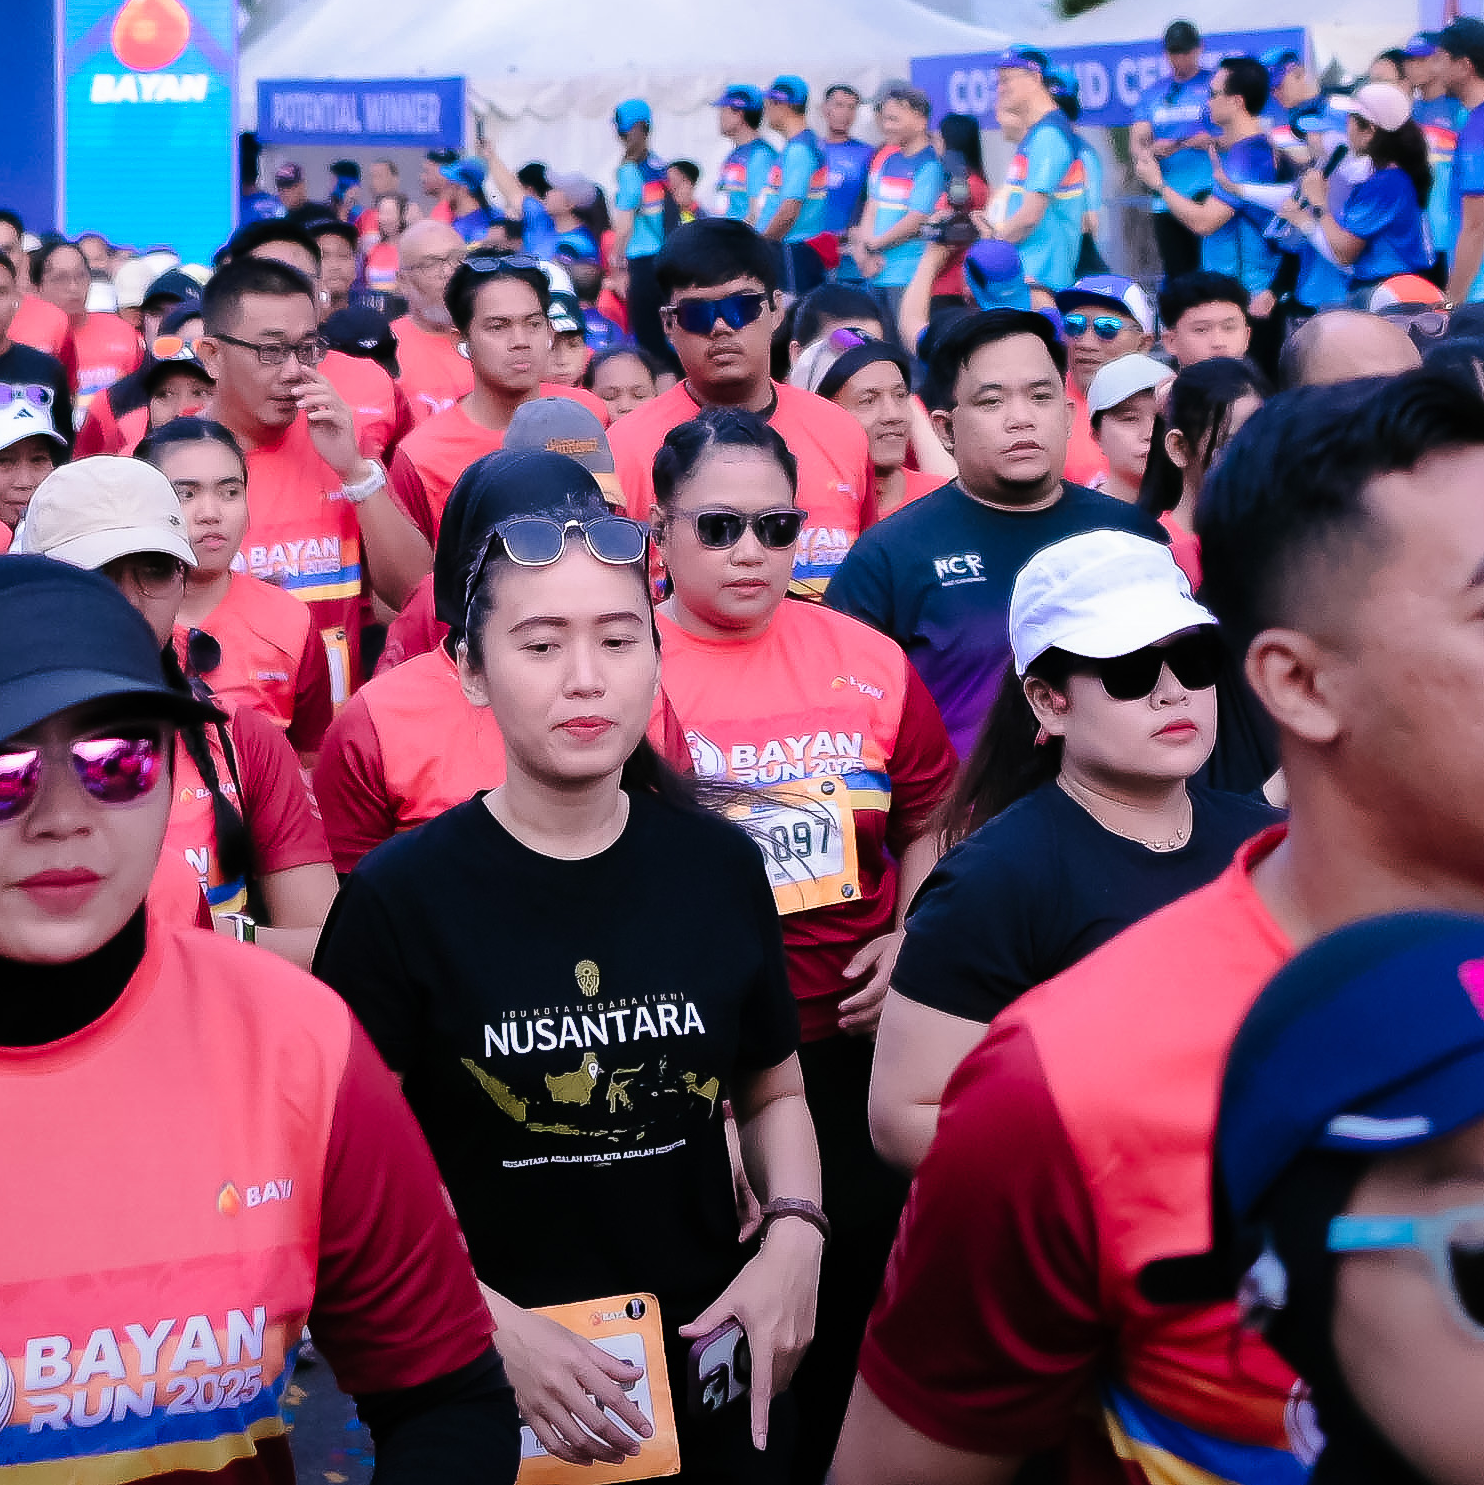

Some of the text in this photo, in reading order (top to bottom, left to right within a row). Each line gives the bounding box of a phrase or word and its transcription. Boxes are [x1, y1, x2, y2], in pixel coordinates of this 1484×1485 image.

[89, 73, 208, 104] BAYAN
[250, 536, 341, 567] BAYAN
[932, 552, 985, 580] NCR
[731, 730, 863, 770] BAYAN
[533, 1004, 570, 1016] KOTA
[576, 996, 639, 1013] NEGARA
[483, 1002, 707, 1058] NUSANTARA
[23, 1305, 267, 1391] BAYAN
[23, 1364, 265, 1437] RUN 2025
